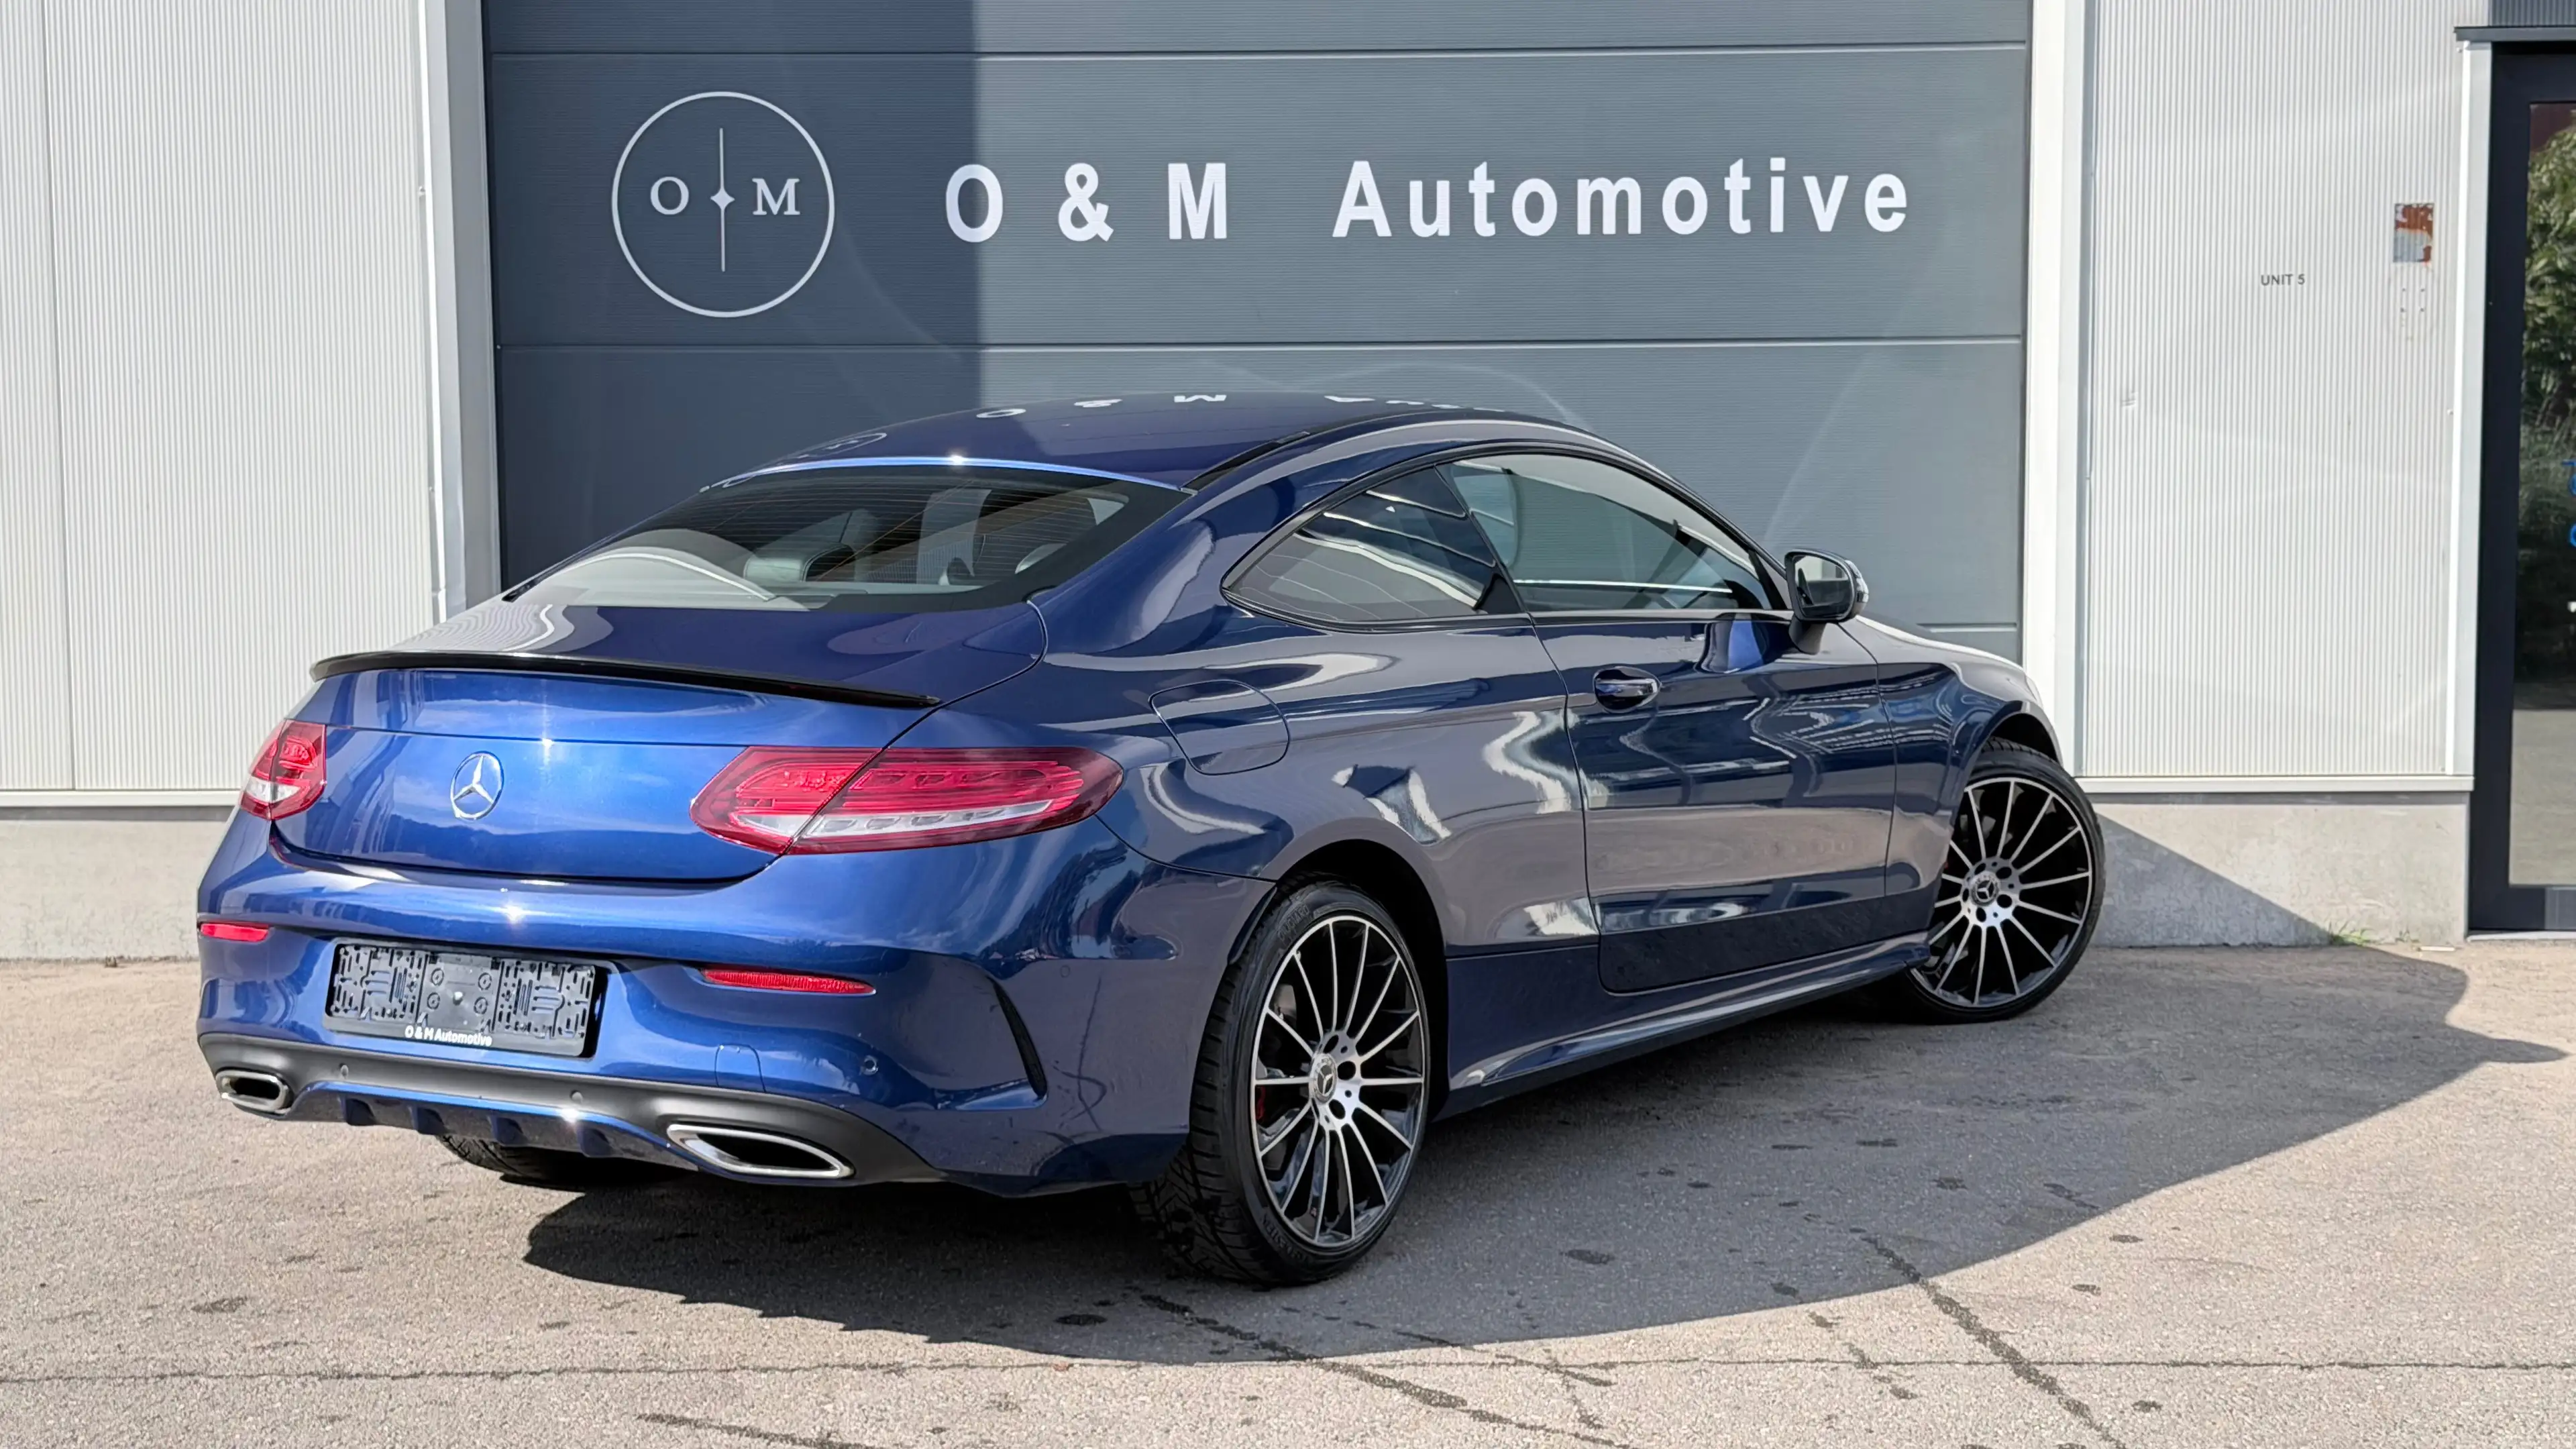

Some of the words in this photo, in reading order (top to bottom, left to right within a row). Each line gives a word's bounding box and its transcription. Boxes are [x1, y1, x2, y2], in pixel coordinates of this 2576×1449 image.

[650, 176, 690, 215] O
[752, 177, 801, 215] M
[946, 164, 1004, 242] O
[1058, 162, 1114, 242] &
[1168, 162, 1228, 239] M
[1332, 157, 1908, 237] Automotive
[2261, 273, 2293, 286] UNIT
[2298, 273, 2305, 285] 5
[405, 1024, 414, 1038] O
[414, 1026, 423, 1039] &
[423, 1027, 434, 1040] M
[434, 1028, 492, 1046] Automotive
